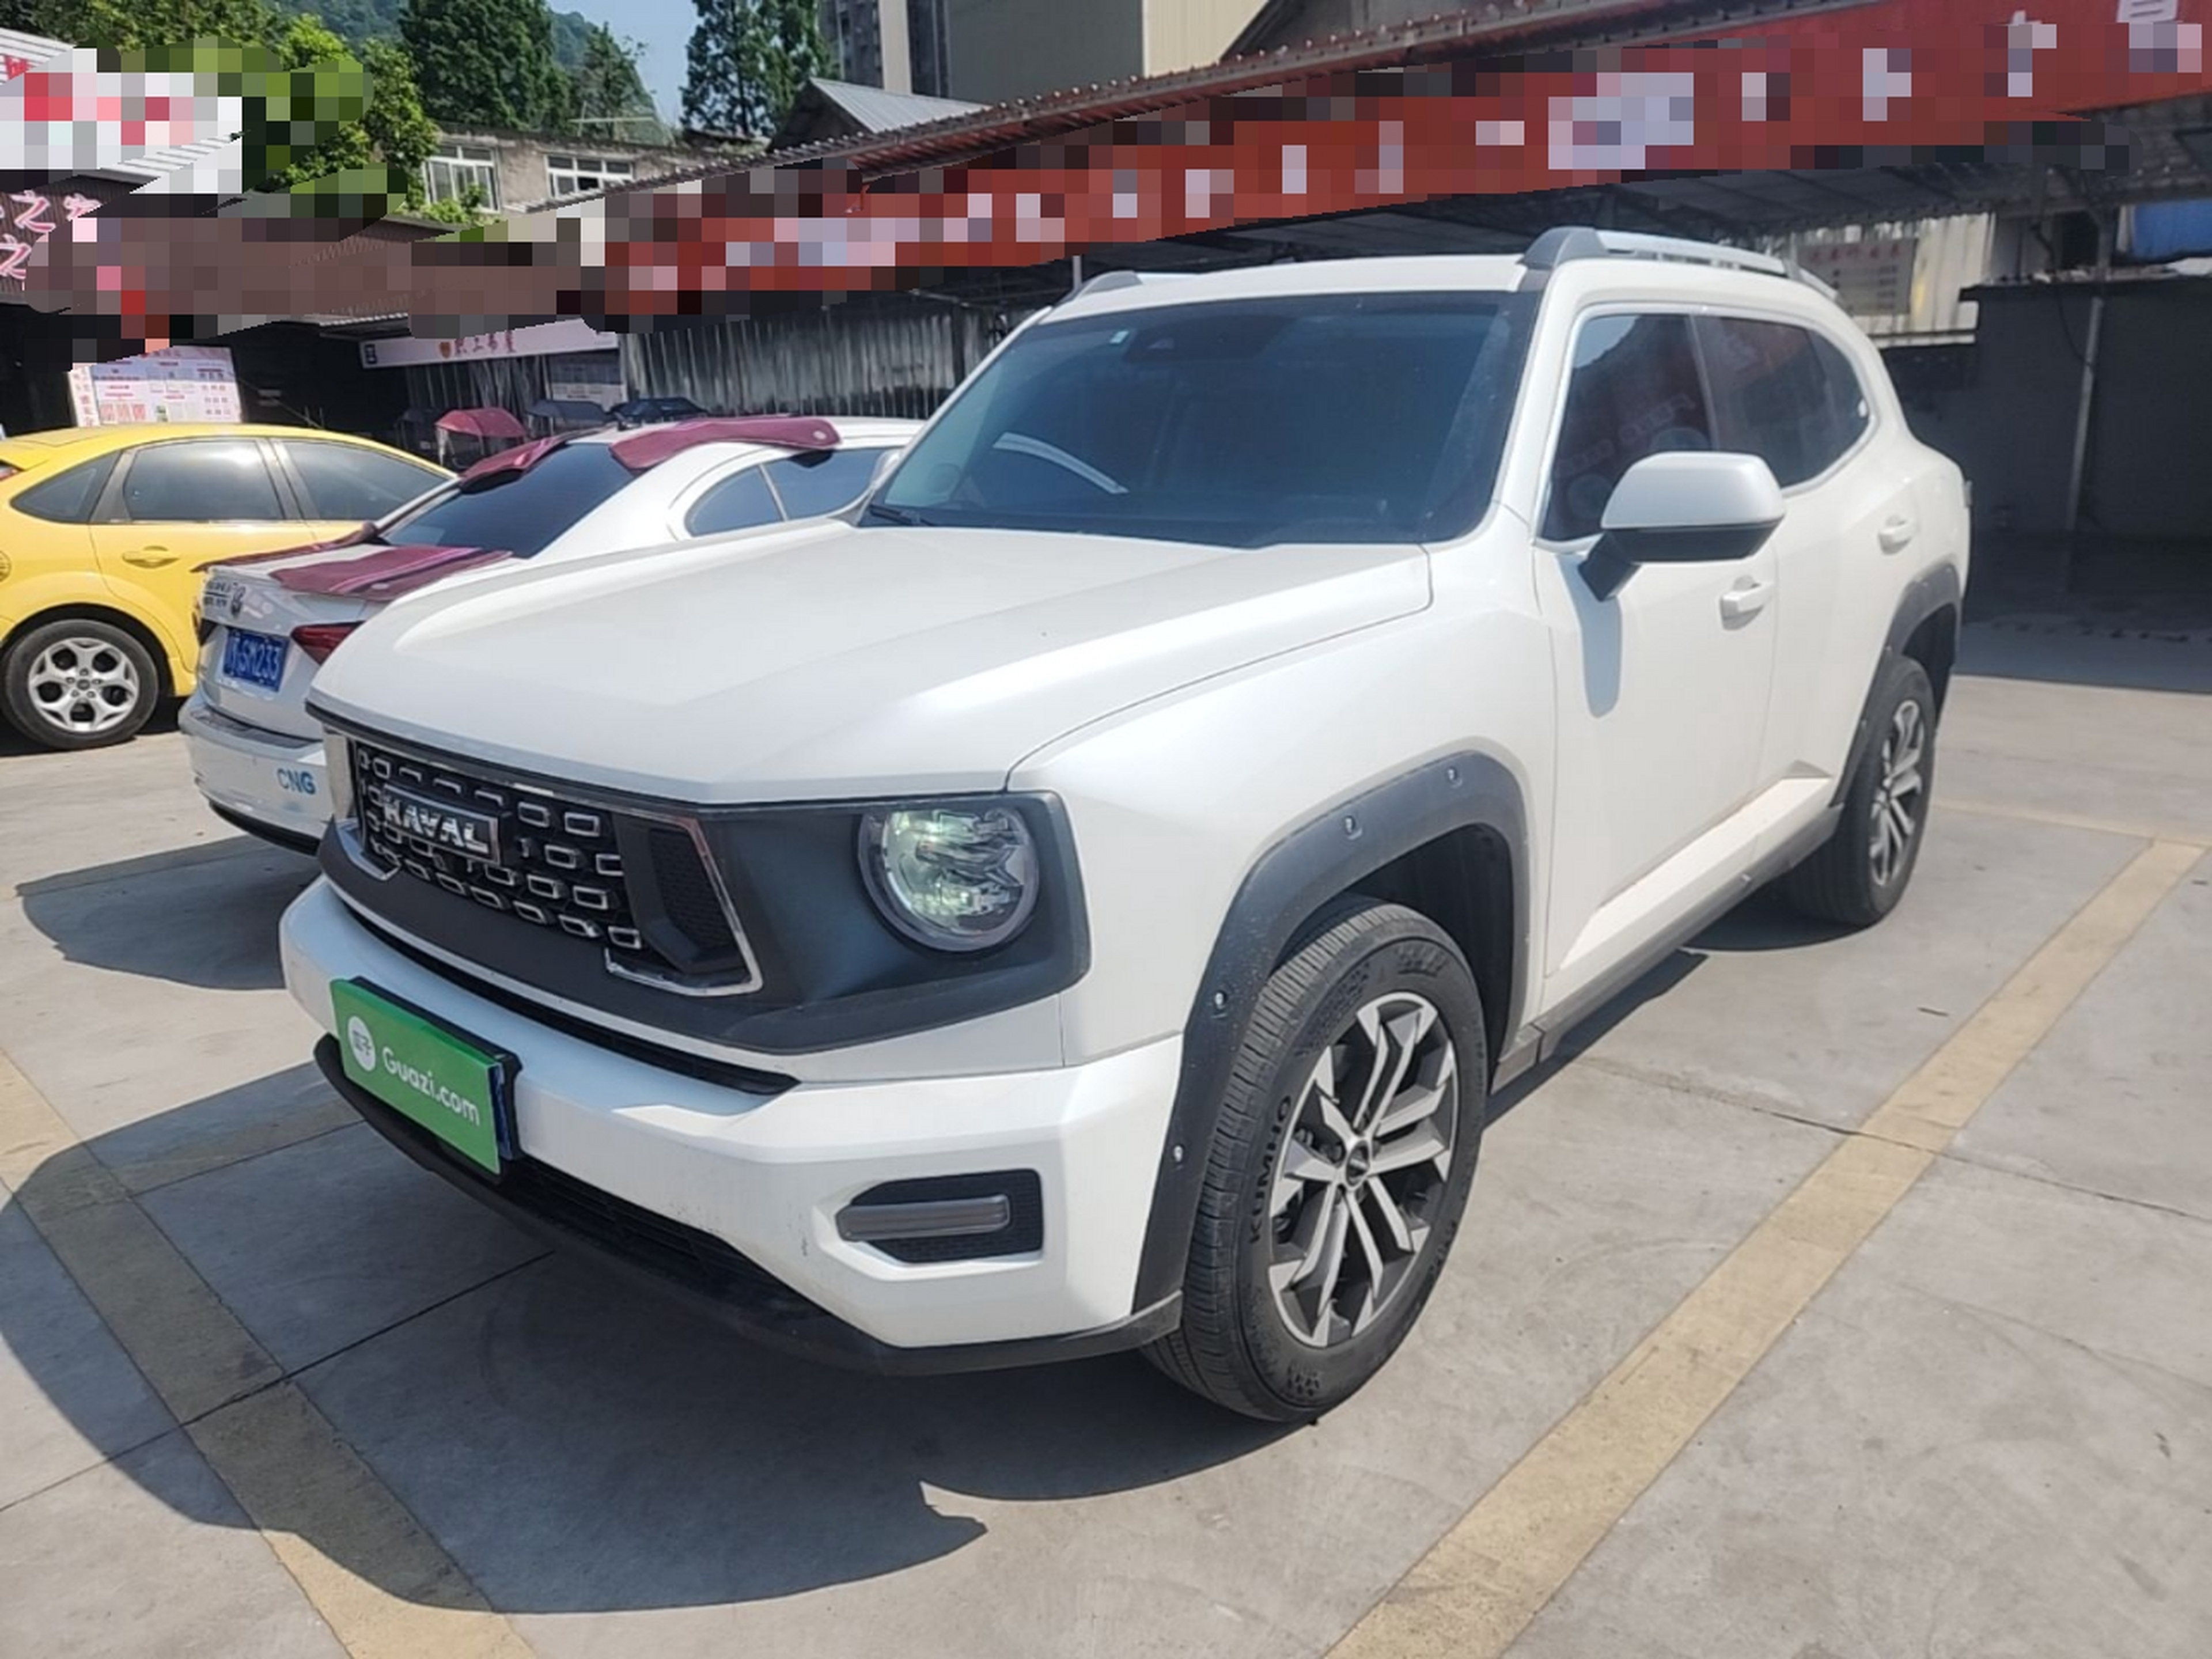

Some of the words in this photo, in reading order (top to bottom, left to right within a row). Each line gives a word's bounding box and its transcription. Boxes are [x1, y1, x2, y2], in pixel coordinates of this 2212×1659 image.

[276, 768, 316, 795] CNG
[382, 1046, 480, 1126] Guazi.com
[1249, 1095, 1291, 1244] KUMHO
